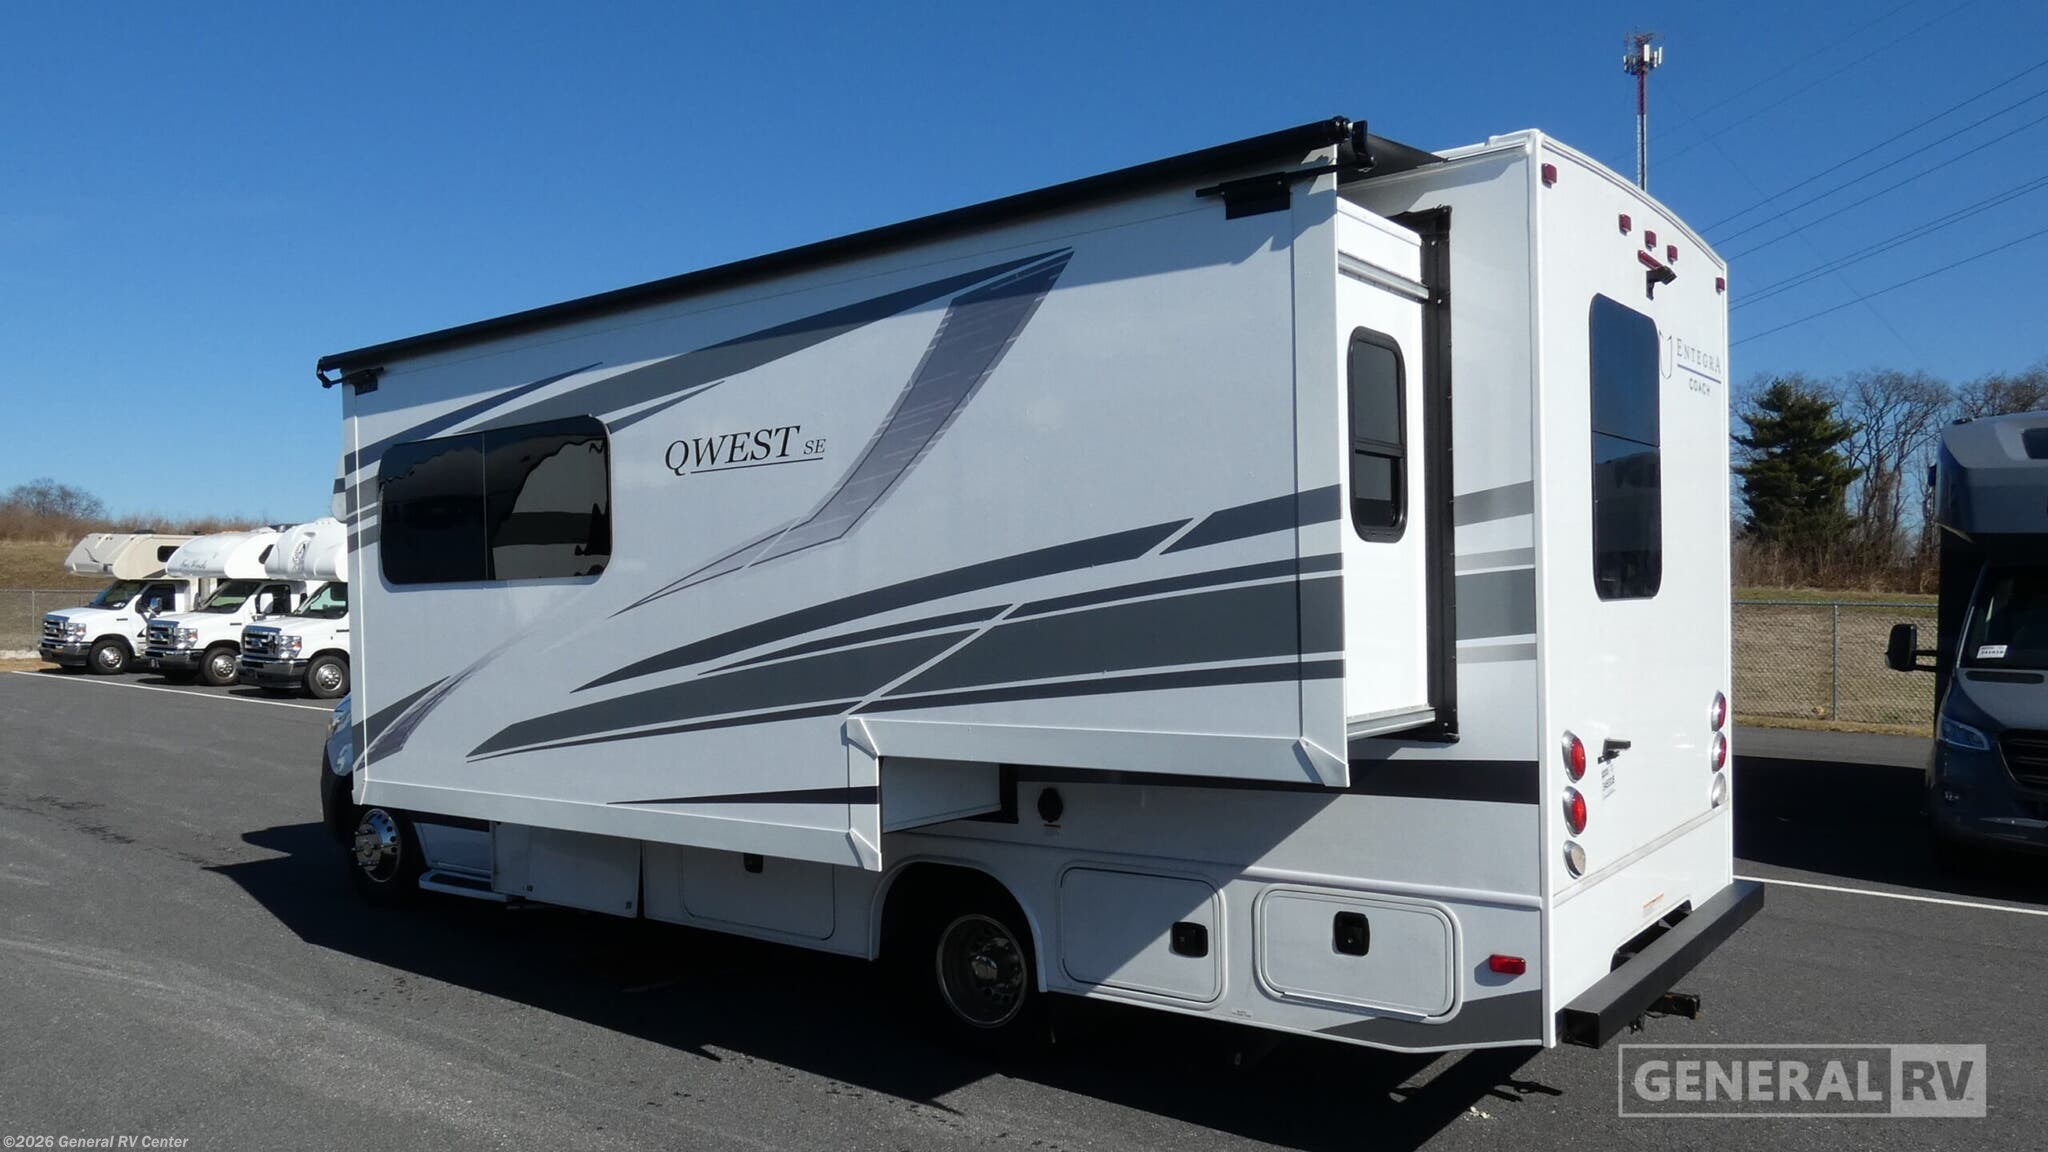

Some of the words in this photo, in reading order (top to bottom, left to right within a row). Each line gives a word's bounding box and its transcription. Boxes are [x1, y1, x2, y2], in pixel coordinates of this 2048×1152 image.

[1676, 337, 1721, 374] ENTEGRA
[1689, 377, 1711, 396] COACH
[665, 425, 801, 476] QWEST
[803, 438, 827, 455] SE
